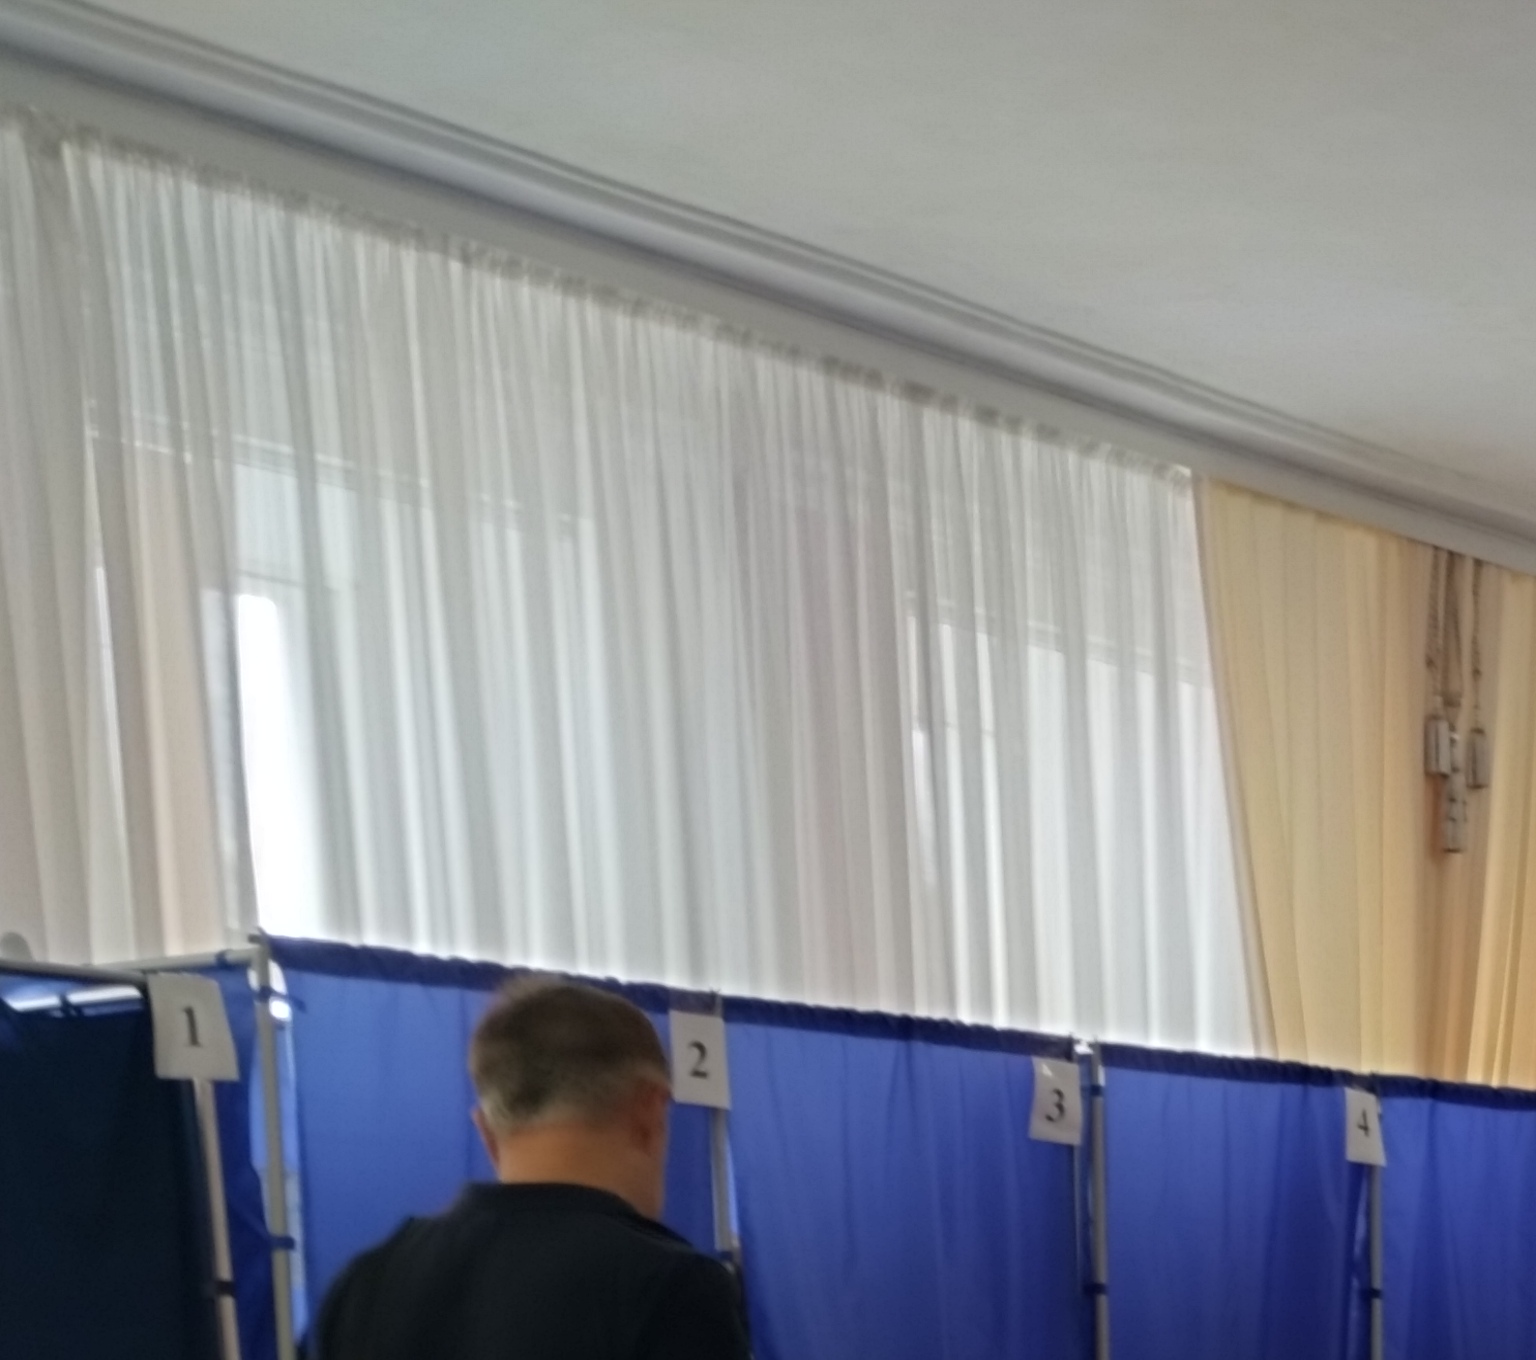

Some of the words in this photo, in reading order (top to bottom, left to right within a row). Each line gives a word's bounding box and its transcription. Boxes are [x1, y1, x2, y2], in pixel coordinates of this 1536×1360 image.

[183, 1006, 202, 1048] 1
[689, 1041, 709, 1079] 2
[1045, 1088, 1065, 1122] 3
[1356, 1108, 1370, 1138] 4
